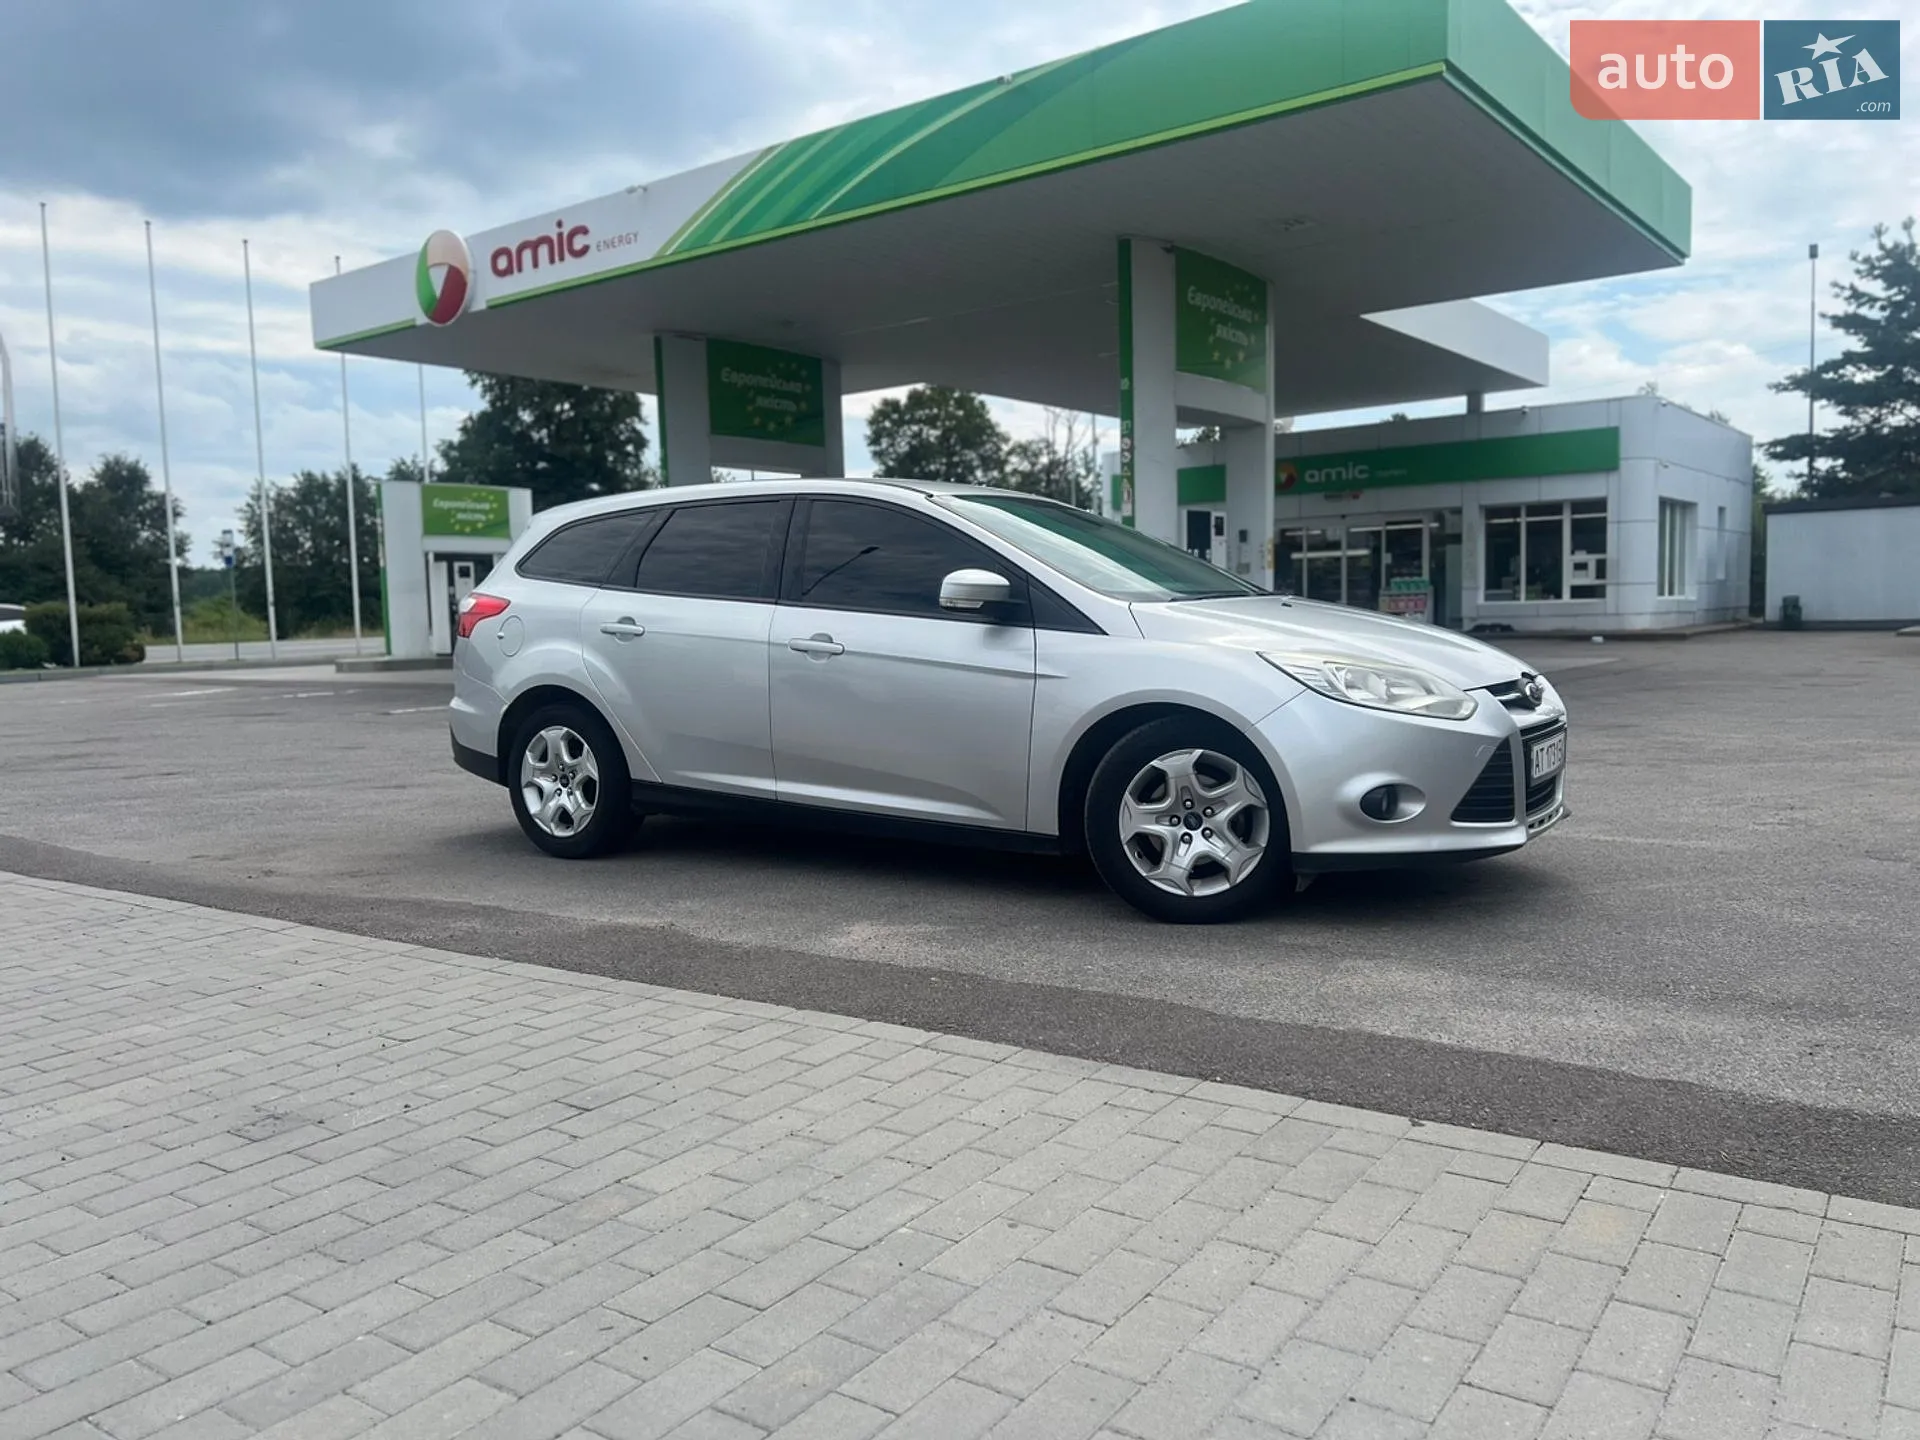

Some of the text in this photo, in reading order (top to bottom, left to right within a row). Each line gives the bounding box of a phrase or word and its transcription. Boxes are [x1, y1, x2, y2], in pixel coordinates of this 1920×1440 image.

[490, 218, 639, 277] amic ENERGY
[1304, 461, 1370, 484] amic
